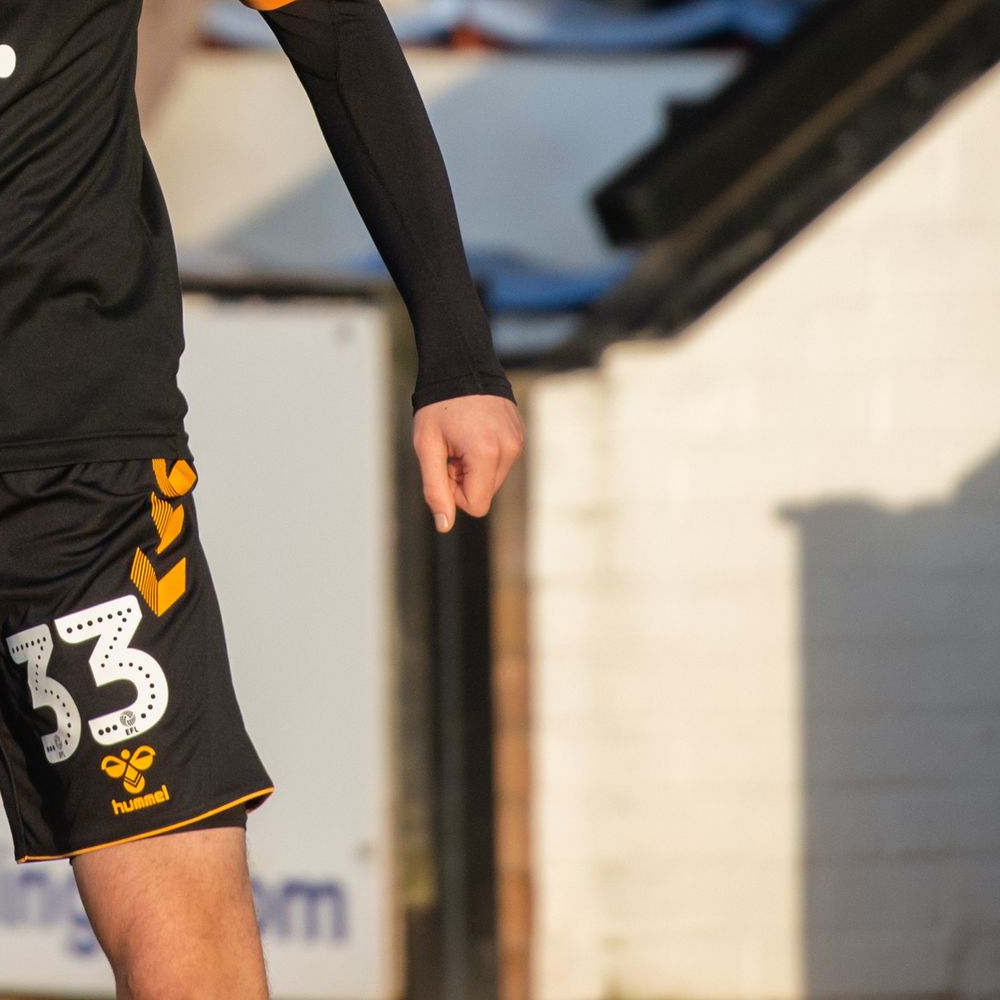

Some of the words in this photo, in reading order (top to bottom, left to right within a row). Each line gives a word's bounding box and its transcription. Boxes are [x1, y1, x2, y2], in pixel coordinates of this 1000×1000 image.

[6, 594, 169, 764] 33
[125, 726, 139, 736] EFL
[111, 785, 170, 815] hummel
